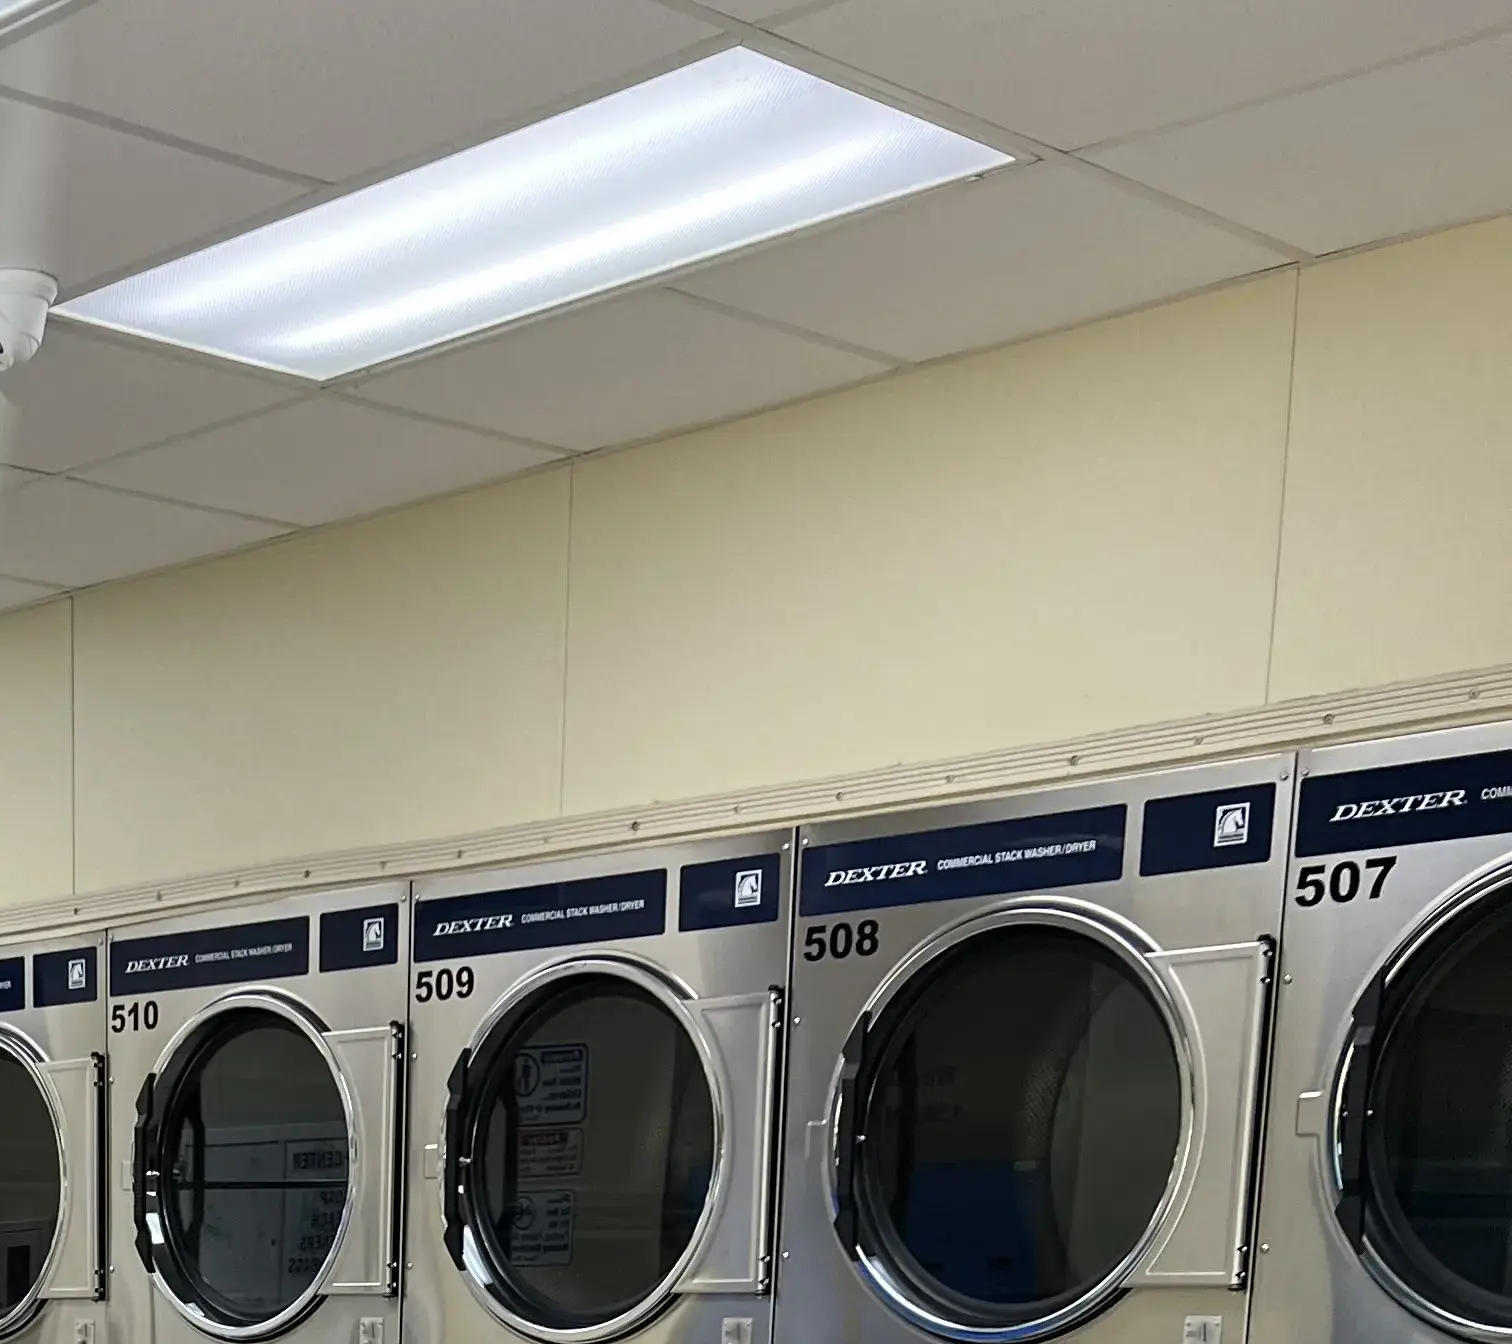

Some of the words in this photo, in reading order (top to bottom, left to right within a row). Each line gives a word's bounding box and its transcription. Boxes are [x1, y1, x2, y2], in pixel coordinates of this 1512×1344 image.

[1328, 789, 1466, 822] DEXTER
[824, 860, 926, 887] DEXTER
[937, 853, 994, 870] COMMERCIAL
[994, 849, 1023, 864] STACK
[1294, 856, 1397, 907] 507
[433, 914, 514, 936] DEXTER
[565, 906, 589, 918] STACK
[803, 919, 880, 962] 508
[125, 954, 189, 973] DEXTER
[415, 966, 474, 1003] 509
[111, 1000, 158, 1033] 510
